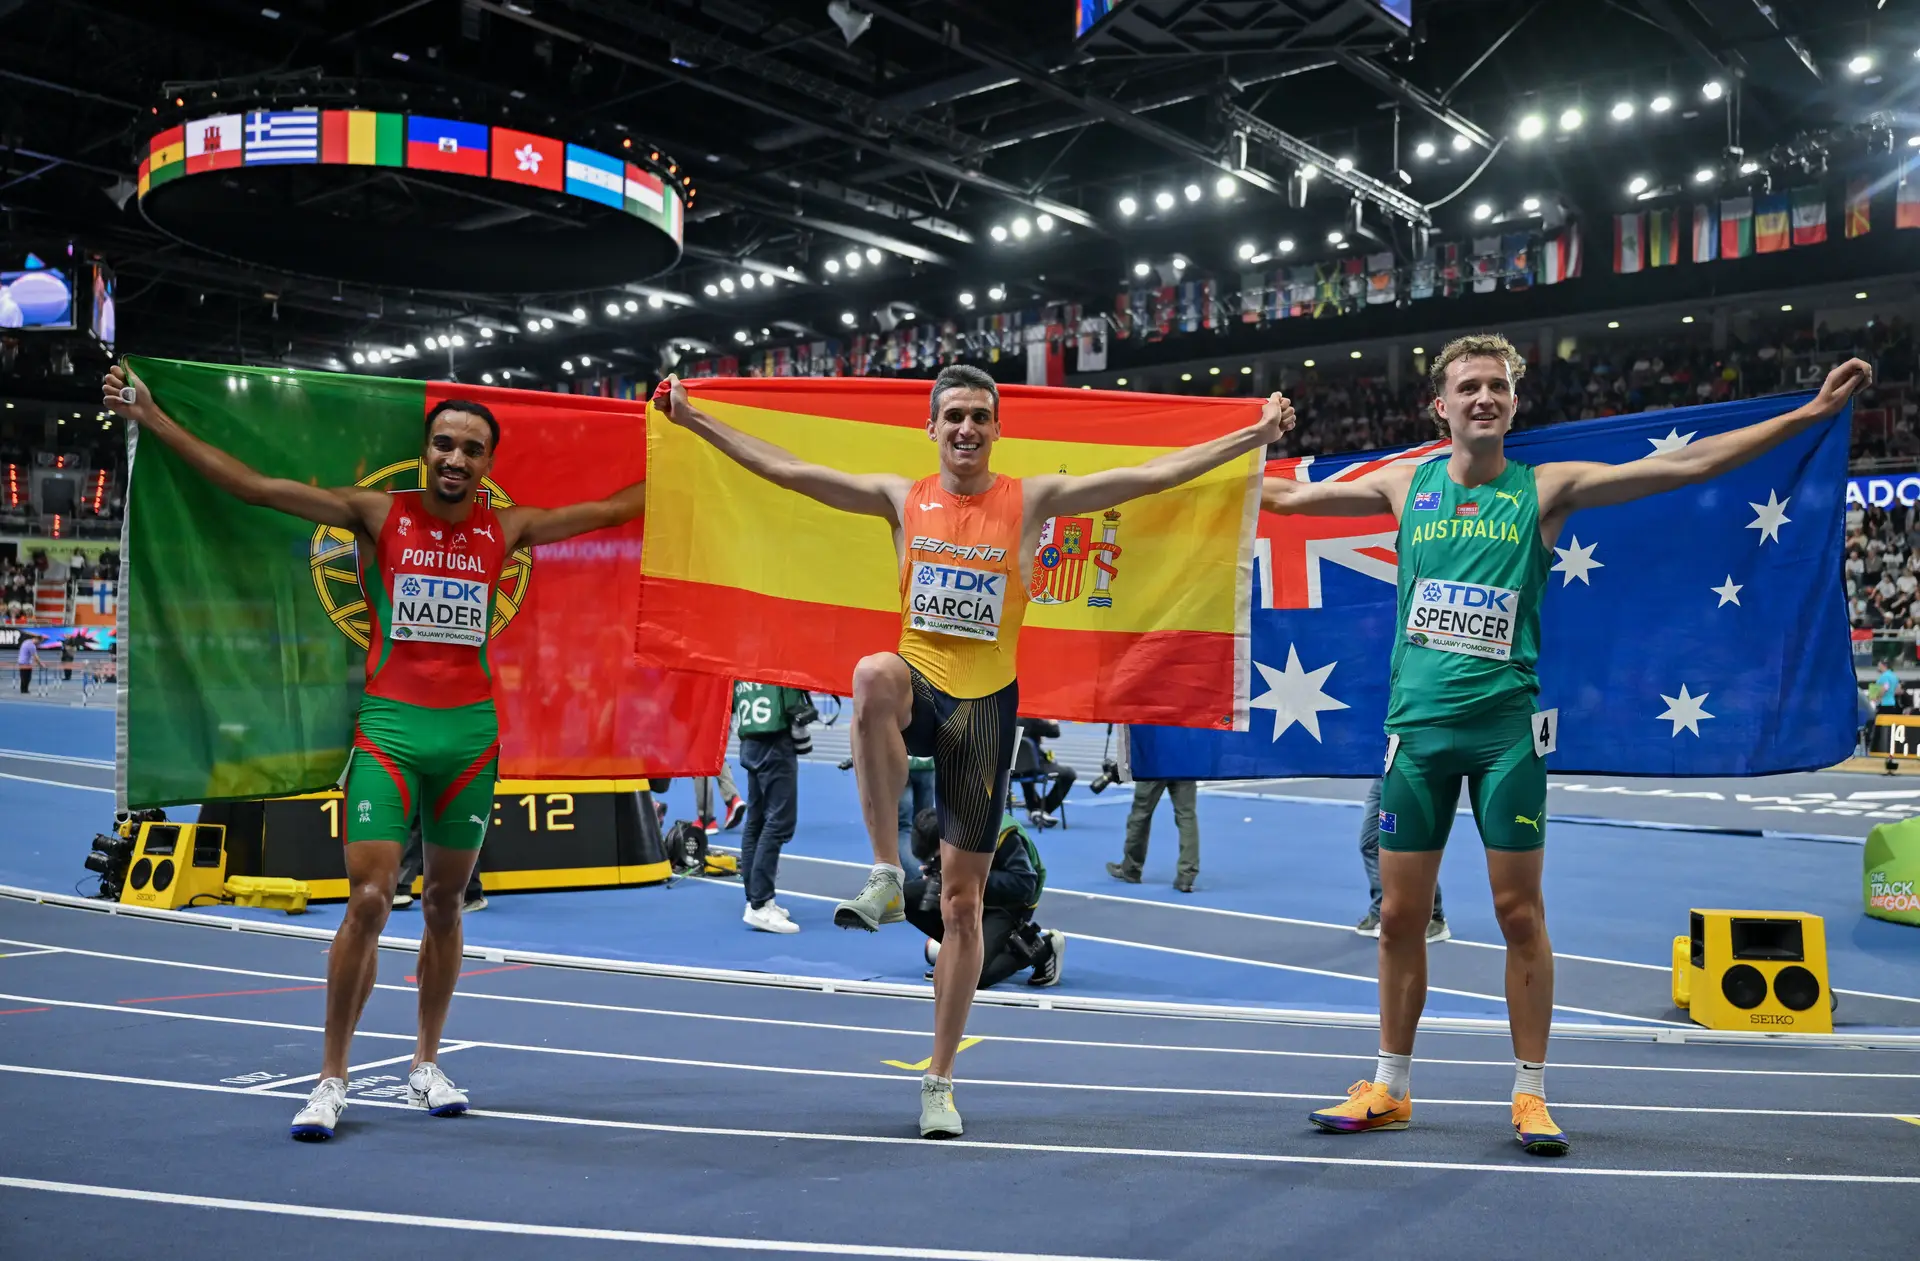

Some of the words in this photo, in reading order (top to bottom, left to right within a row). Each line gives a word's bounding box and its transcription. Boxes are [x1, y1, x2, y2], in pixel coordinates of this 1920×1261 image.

[1796, 365, 1821, 383] L2
[1412, 519, 1519, 545] AUSTRALIA
[401, 548, 486, 573] PORTUGAL
[910, 535, 1007, 563] ESPAÑA
[421, 578, 482, 604] TDK
[934, 567, 999, 596] TDK
[914, 593, 995, 623] GARCÍA
[1442, 583, 1511, 613] TDK
[398, 601, 482, 628] NADER
[927, 621, 954, 629] KUJAWY
[1413, 606, 1510, 640] SPENCER
[417, 630, 445, 638] KUJAWY
[445, 633, 475, 642] POMORZE
[1432, 638, 1461, 647] KUJAWY
[1461, 642, 1496, 654] POMORZE
[1496, 648, 1506, 656] 26
[737, 696, 772, 727] 26
[1539, 716, 1550, 747] 4
[1871, 881, 1913, 897] TRACK
[1750, 1014, 1794, 1026] SEIKO
